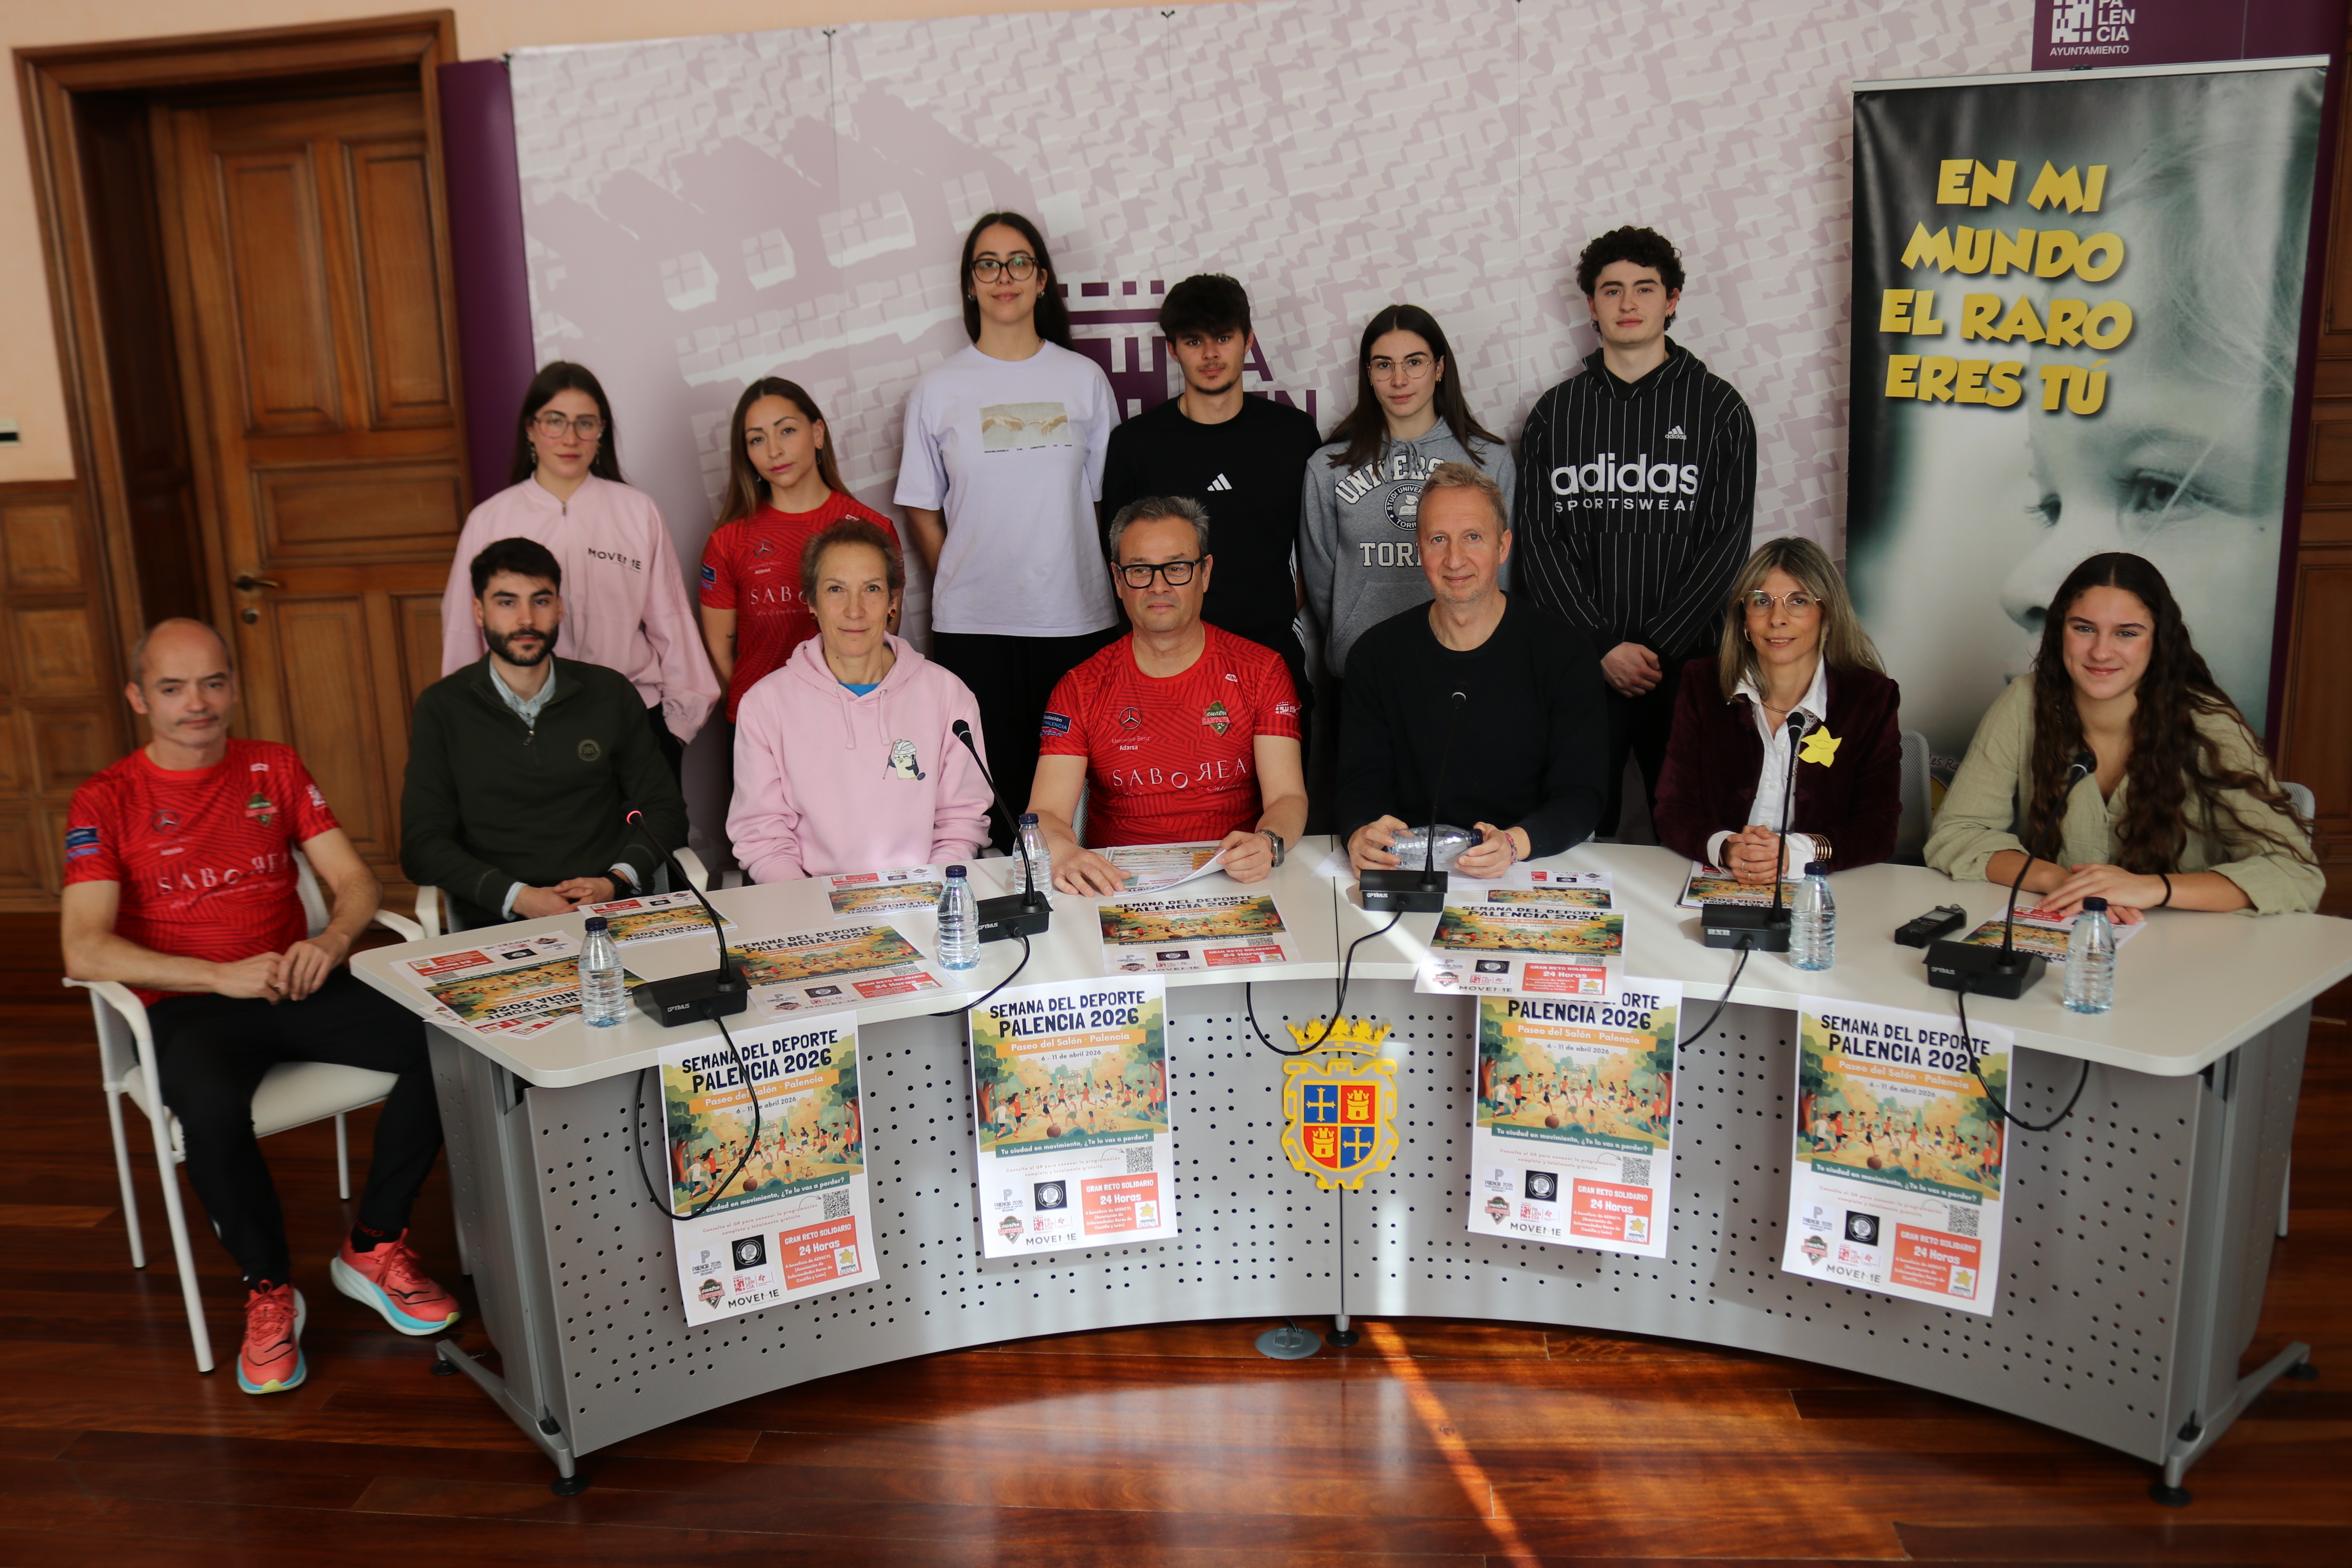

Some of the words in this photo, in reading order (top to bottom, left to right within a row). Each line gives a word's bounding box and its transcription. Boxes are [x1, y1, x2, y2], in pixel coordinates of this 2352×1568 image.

[2098, 9, 2135, 25] LEN
[2096, 26, 2130, 42] CIA
[2050, 45, 2129, 56] AYUNTAMIENTO
[1936, 158, 2017, 207] EN
[2027, 160, 2107, 214] MI
[1900, 221, 2124, 282] MUNDO
[1879, 289, 1943, 335] EL
[1960, 293, 2132, 350] RARO
[1885, 354, 2024, 407] ERES
[2039, 358, 2110, 415] TÚ
[1551, 452, 1699, 495] adidas
[1387, 491, 1398, 511] STUDI
[1396, 519, 1417, 529] TORI
[1124, 903, 1202, 913] PALENCIA
[1467, 911, 1549, 919] PALENCIA
[734, 938, 784, 949] SEMANA
[815, 926, 877, 937] DEPORTE
[746, 938, 826, 953] PALENCIA
[829, 931, 874, 941] 2026
[989, 1000, 1044, 1019] SEMANA
[1049, 996, 1076, 1012] DEL
[1080, 991, 1145, 1008] DEPORTE
[1509, 999, 1595, 1024] PALENCIA
[1601, 1008, 1651, 1030] 2026
[999, 1012, 1085, 1038] PALENCIA
[1090, 1007, 1139, 1027] 2026
[1011, 1043, 1037, 1051] Paseo
[1040, 1039, 1054, 1048] del
[1057, 1037, 1082, 1046] Salón
[1090, 1032, 1129, 1042] Palencia
[1518, 1025, 1544, 1034] Paseo
[1548, 1027, 1561, 1036] del
[1565, 1029, 1590, 1039] Salón
[1599, 1033, 1640, 1045] Palencia
[1821, 1015, 1878, 1036] SEMANA
[1884, 1024, 1913, 1042] DEL
[1918, 1029, 1991, 1056] DEPORTE
[682, 1049, 738, 1074] SEMANA
[741, 1043, 769, 1061] DEL
[773, 1030, 837, 1053] DEPORTE
[1829, 1034, 1920, 1065] PALENCIA
[692, 1059, 780, 1093] PALENCIA
[784, 1049, 832, 1073] 2026
[1839, 1060, 1867, 1072] Paseo
[1870, 1065, 1885, 1075] del
[1889, 1069, 1916, 1080] Salón
[1925, 1074, 1969, 1090] Palencia
[705, 1096, 732, 1107] Paseo
[735, 1090, 749, 1100] del
[784, 1075, 823, 1089] Palencia
[1044, 1141, 1082, 1150] movimiento,
[1123, 1134, 1148, 1143] perder?
[1121, 1179, 1154, 1189] SOLIDARIO
[1100, 1195, 1112, 1205] 24
[1114, 1194, 1141, 1203] Horas
[784, 1235, 800, 1245] GRAN
[802, 1231, 818, 1241] RETO
[819, 1223, 851, 1236] SOLIDARIO
[799, 1244, 811, 1256] 24
[813, 1240, 840, 1252] Horas
